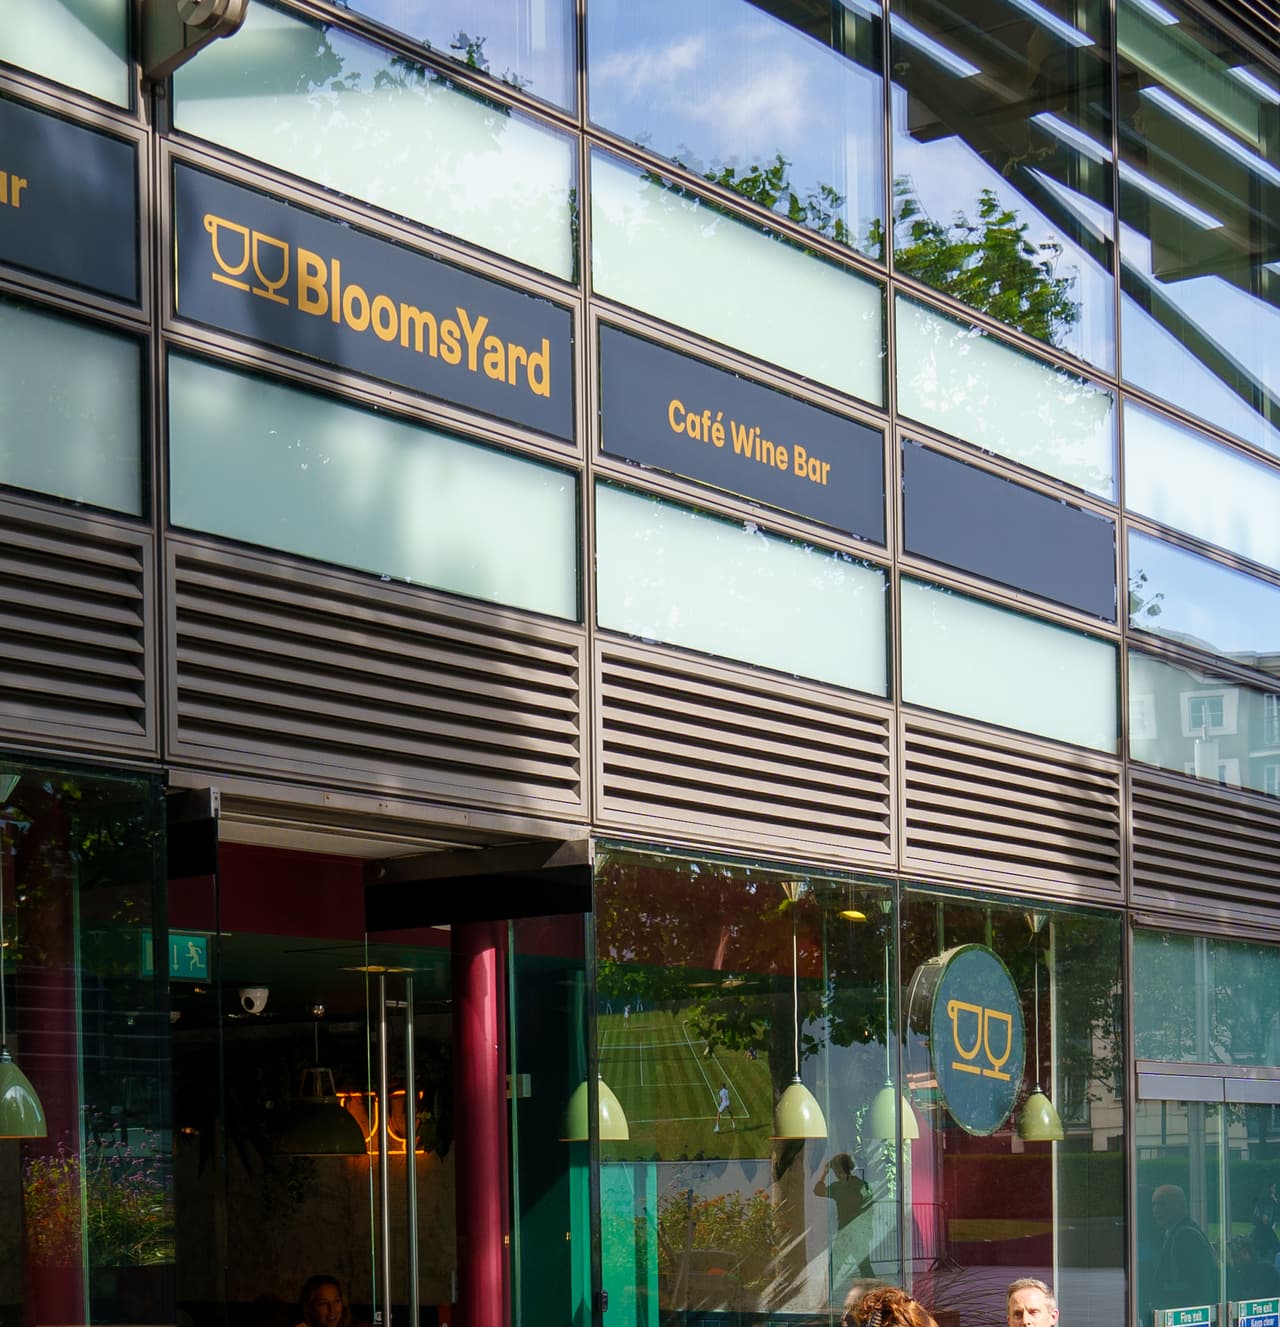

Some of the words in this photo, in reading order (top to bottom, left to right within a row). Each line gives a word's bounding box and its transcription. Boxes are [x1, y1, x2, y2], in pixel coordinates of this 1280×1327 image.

[297, 247, 551, 398] BloomsYard
[669, 399, 725, 448] Café
[730, 420, 789, 471] Wine
[795, 445, 830, 485] Bar
[1181, 1312, 1192, 1322] Fire
[1253, 1304, 1262, 1314] Fire
